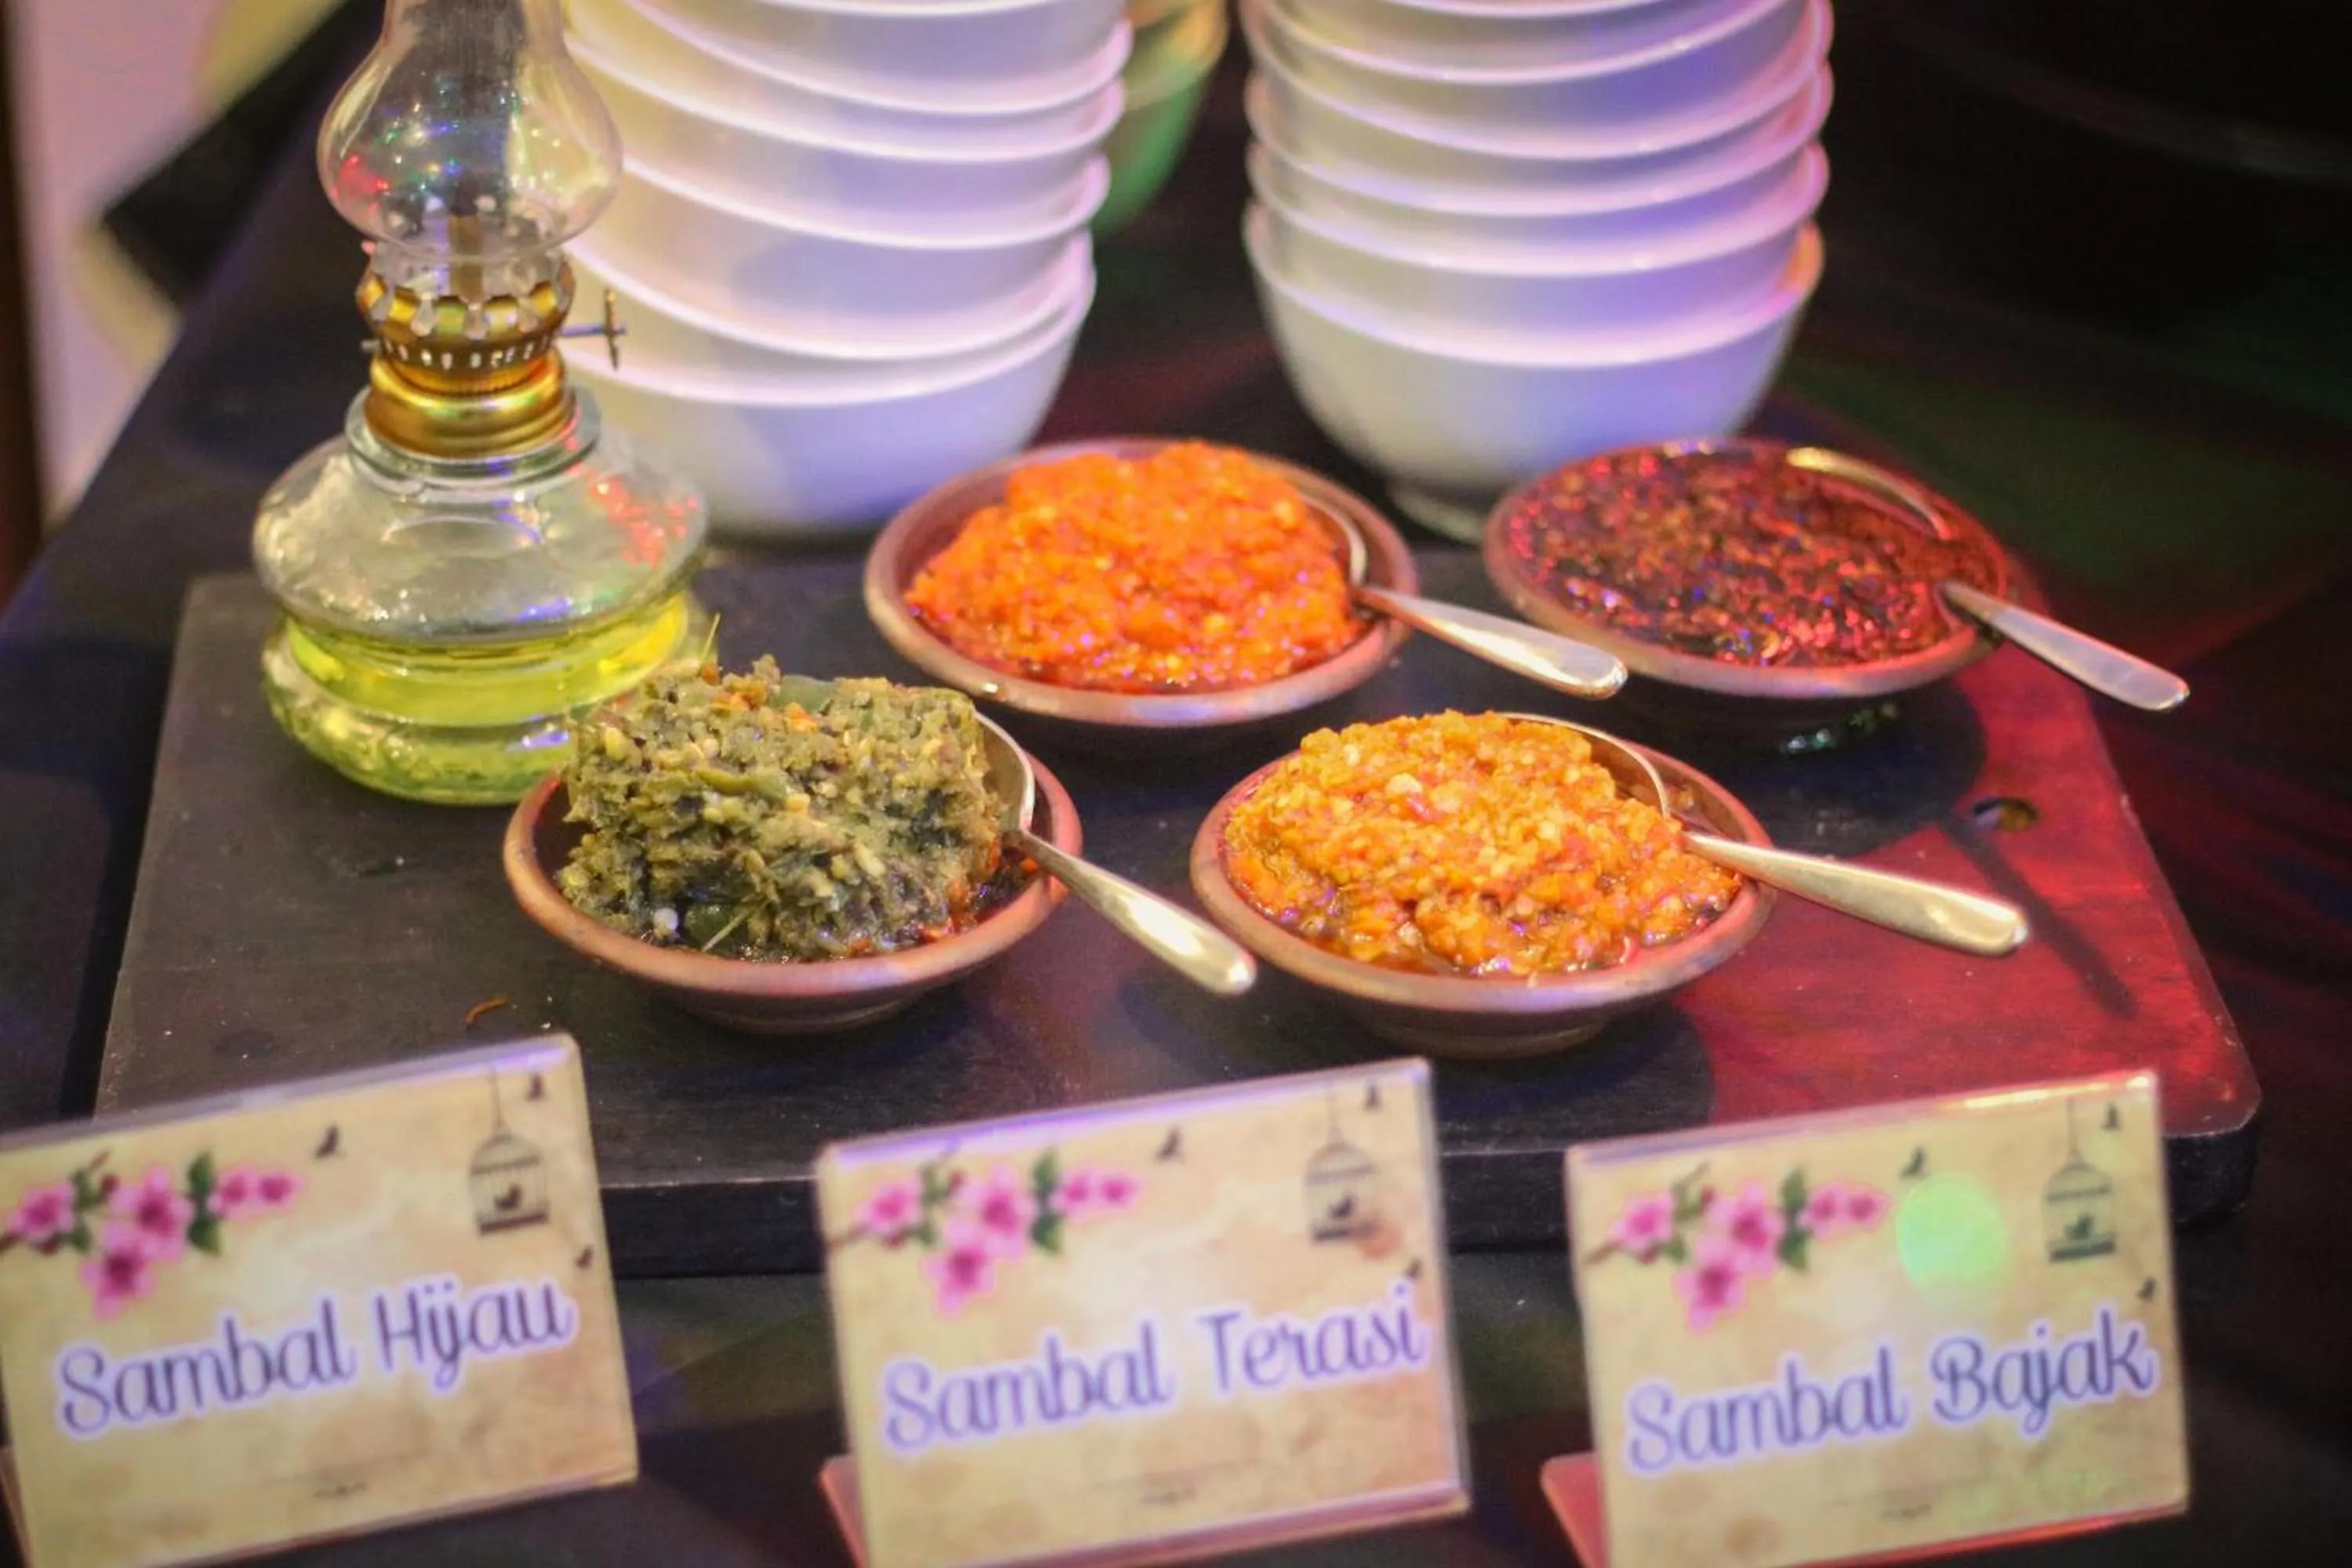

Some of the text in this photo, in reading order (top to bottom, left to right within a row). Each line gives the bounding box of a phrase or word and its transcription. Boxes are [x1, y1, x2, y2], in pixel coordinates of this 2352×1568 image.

[61, 1281, 573, 1434] Sambal Hijau
[885, 1283, 1425, 1449] Sambal Terasi
[1629, 1309, 2154, 1471] Sambal Bajak
